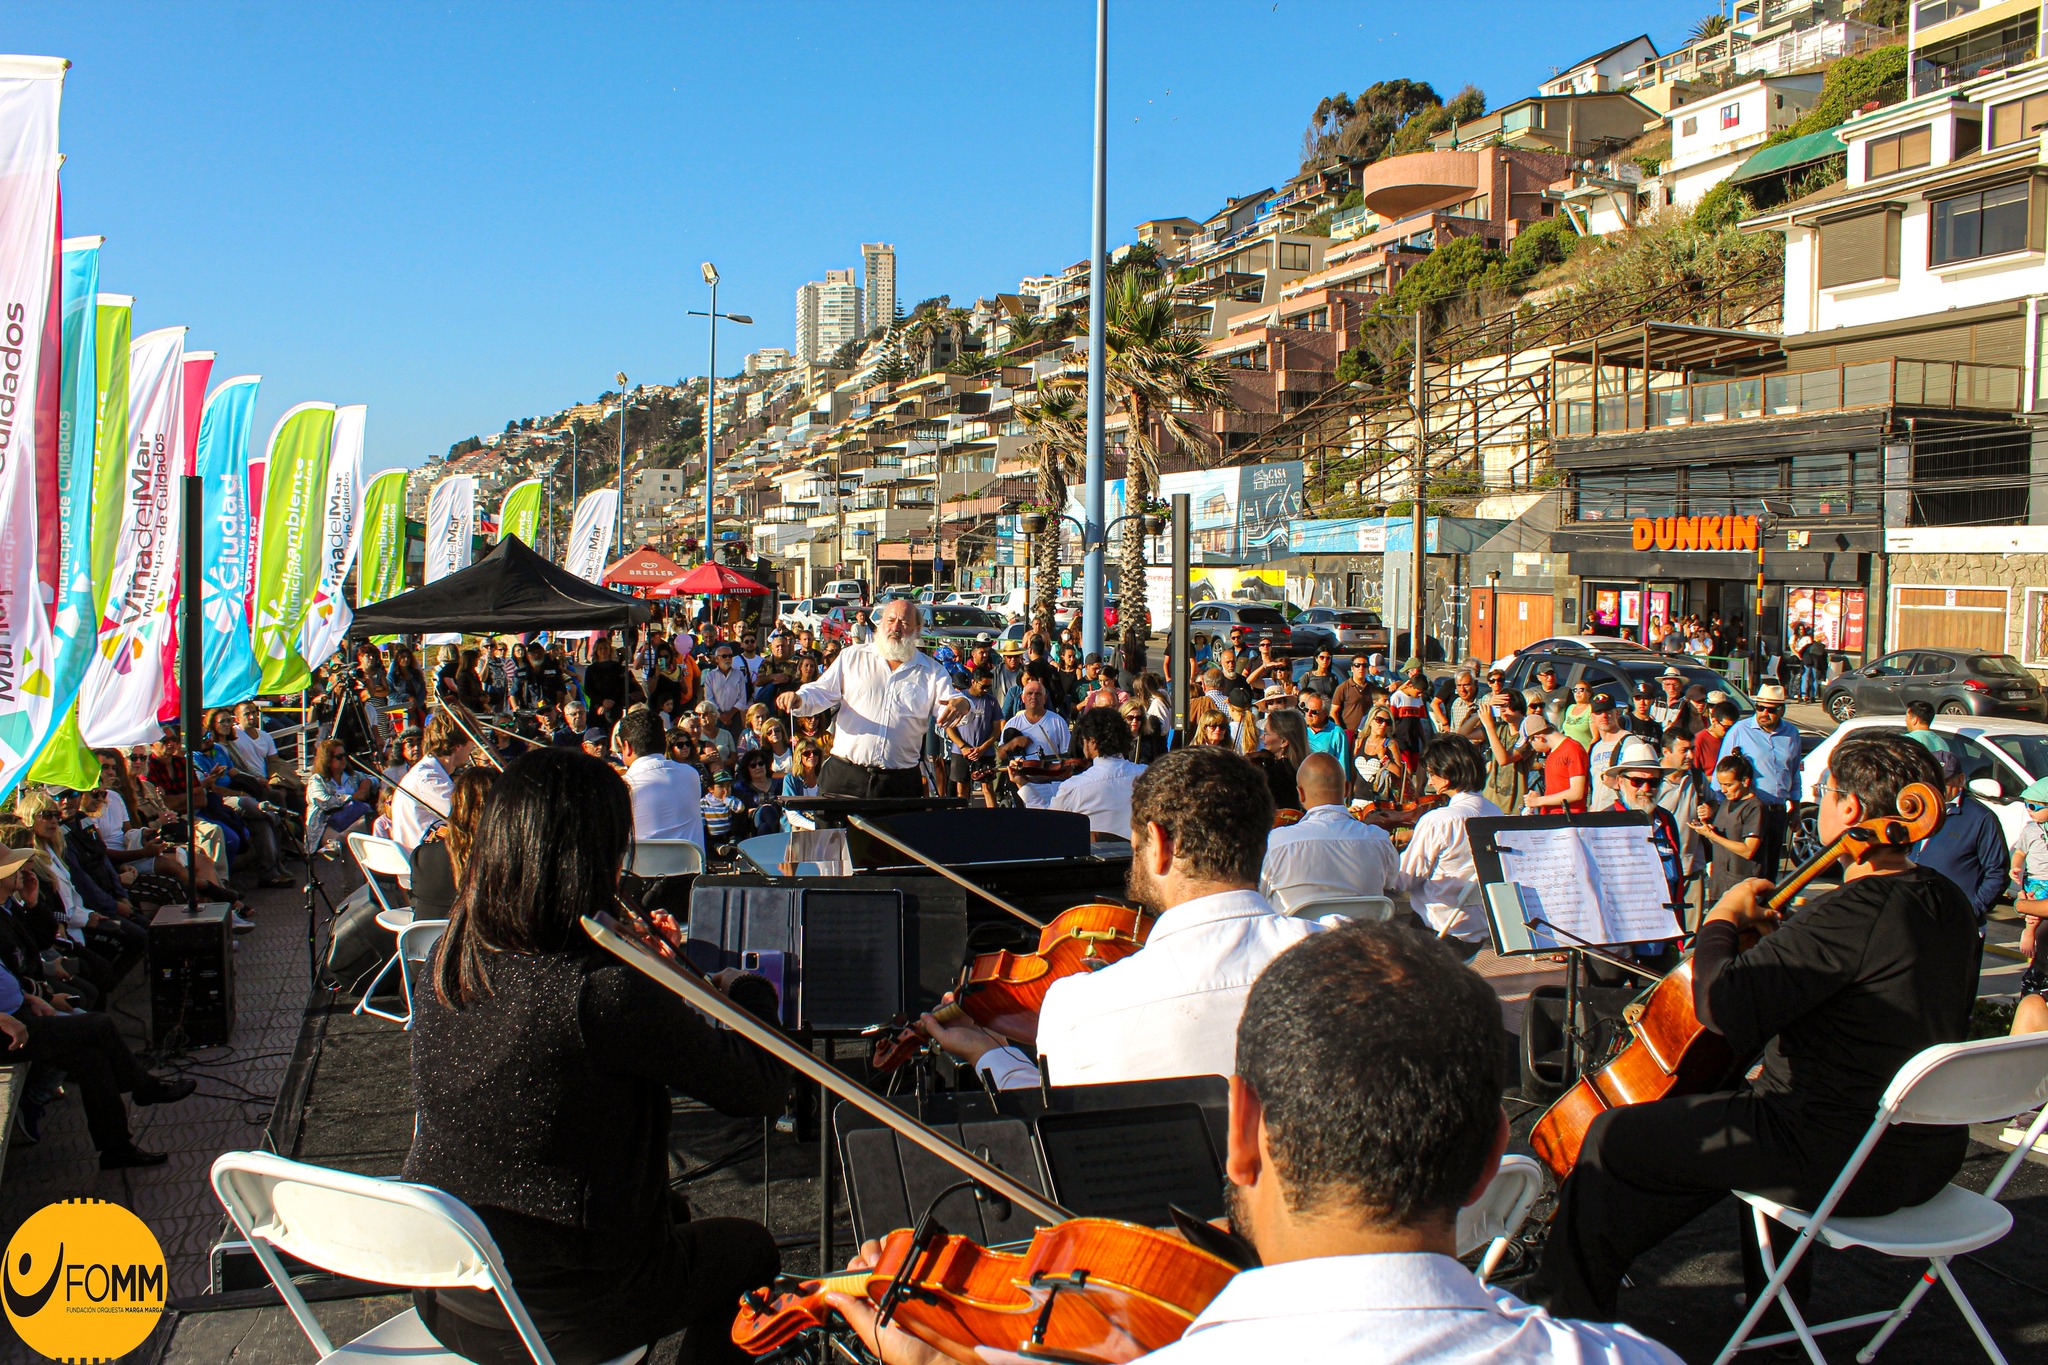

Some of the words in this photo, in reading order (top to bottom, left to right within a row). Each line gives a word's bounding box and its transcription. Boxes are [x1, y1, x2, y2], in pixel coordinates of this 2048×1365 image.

[58, 410, 71, 490] Cuidados
[153, 433, 168, 510] Cuidados
[1268, 468, 1287, 479] CASA
[60, 496, 71, 517] de
[341, 471, 351, 522] Cuidados
[123, 433, 153, 625] ViñadelMar
[155, 515, 168, 537] de
[217, 474, 240, 591] Ciudad
[388, 503, 397, 545] Cuidados
[1632, 514, 1758, 551] DUNKIN
[57, 523, 73, 603] Municipio
[142, 539, 165, 618] Municipio
[629, 569, 674, 577] BRESLER
